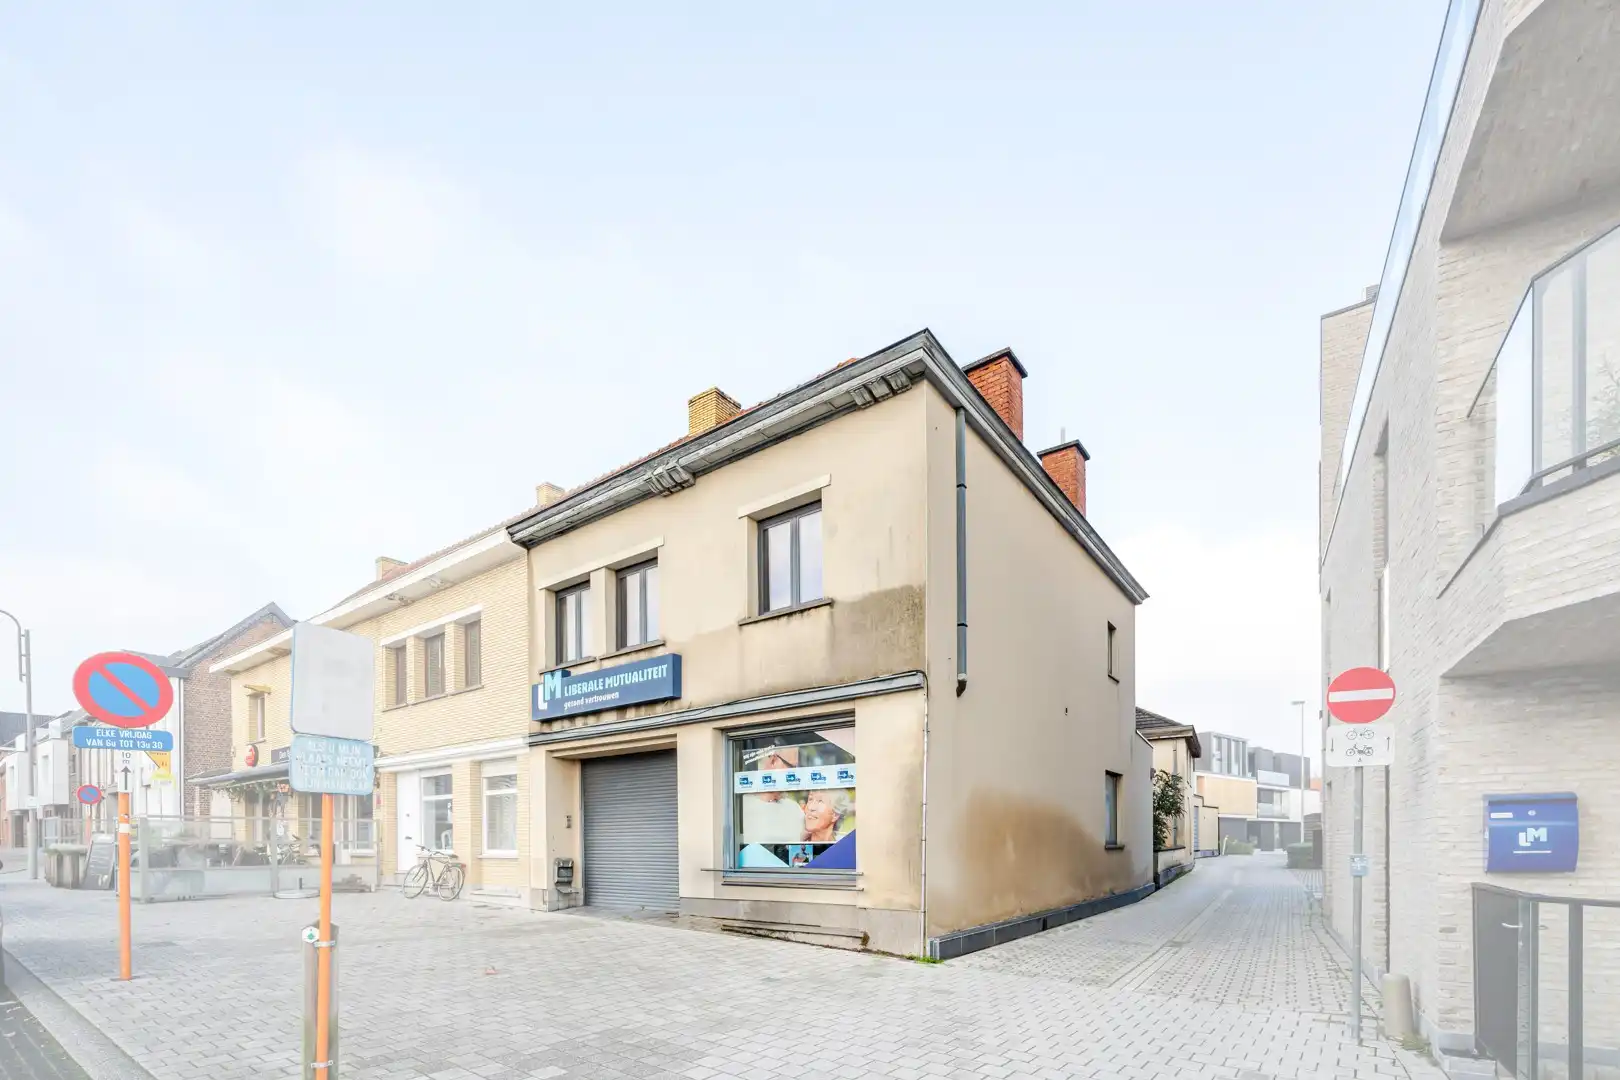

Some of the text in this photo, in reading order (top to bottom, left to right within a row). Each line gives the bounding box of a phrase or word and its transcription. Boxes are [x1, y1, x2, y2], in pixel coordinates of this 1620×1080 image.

[564, 677, 604, 697] LIBERALE
[605, 663, 668, 690] MUTUALITEIT
[564, 691, 620, 711] gezond vertrouwen
[96, 728, 152, 739] ELKE VRIJDAG
[86, 738, 103, 747] VAN
[119, 740, 133, 748] TOT
[136, 741, 150, 749] 13u
[152, 741, 163, 750] 30
[338, 743, 361, 755] MIJN
[121, 751, 132, 759] 10
[1518, 827, 1548, 847] LM
